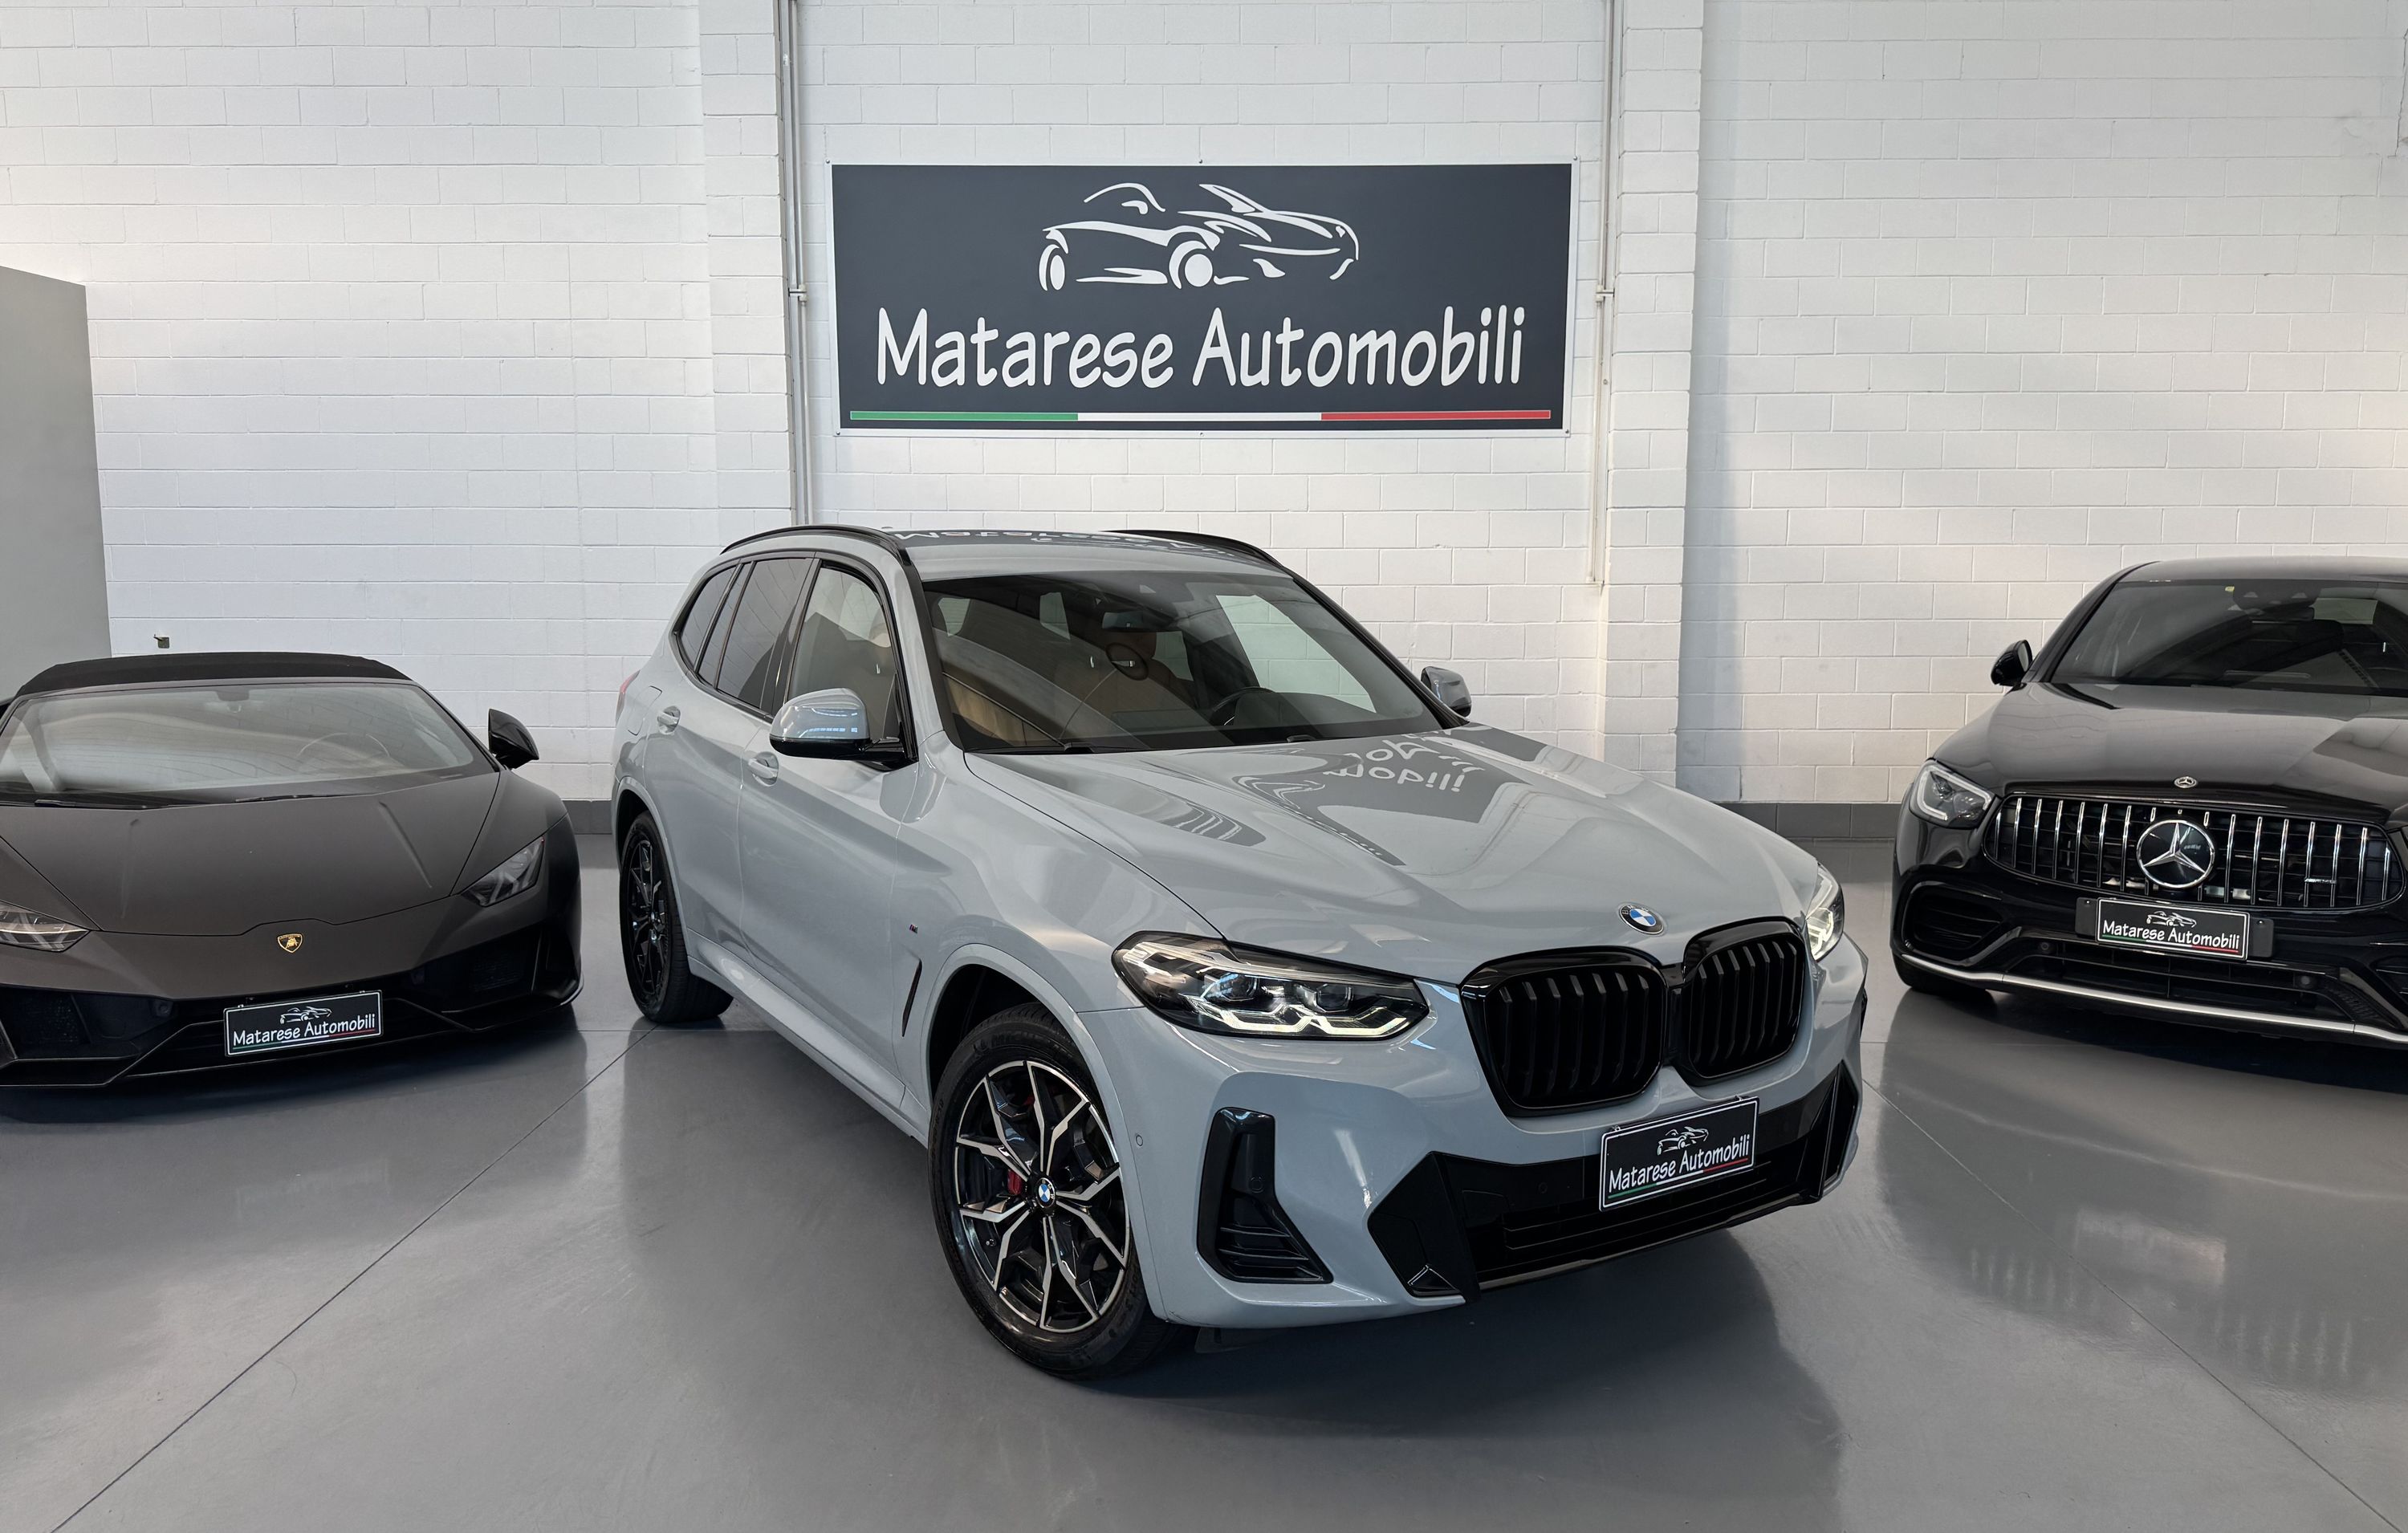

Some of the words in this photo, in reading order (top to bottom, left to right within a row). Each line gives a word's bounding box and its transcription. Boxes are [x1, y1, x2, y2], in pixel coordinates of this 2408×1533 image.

[877, 306, 1173, 388] Matarese
[1191, 304, 1525, 388] Automobili
[2102, 919, 2166, 941] Matarese
[2167, 927, 2240, 950] Automobili
[233, 1027, 301, 1047] Matarese
[303, 1013, 376, 1038] Automobili
[1609, 1160, 1677, 1193] Matarese
[1678, 1133, 1751, 1174] Automobili
